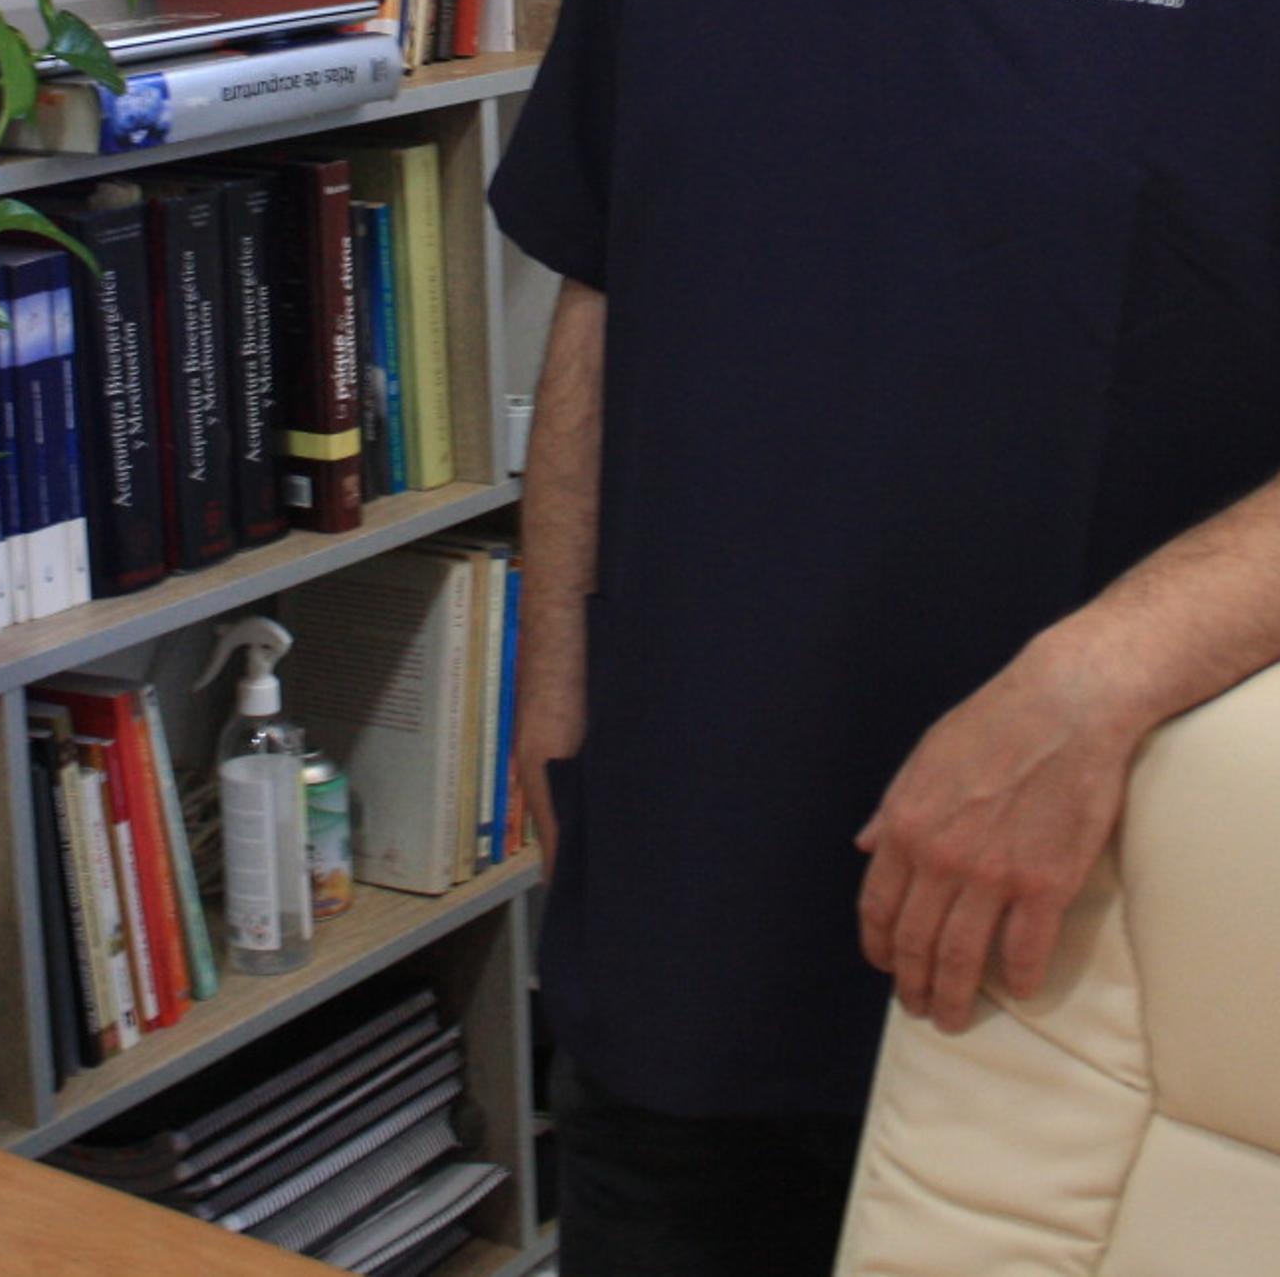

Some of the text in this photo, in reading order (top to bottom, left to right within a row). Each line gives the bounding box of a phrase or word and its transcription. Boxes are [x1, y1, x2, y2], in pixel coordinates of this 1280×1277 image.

[112, 400, 133, 506] Acupuntura
[188, 376, 208, 481] Acupuntura
[243, 359, 264, 461] Acupuntura
